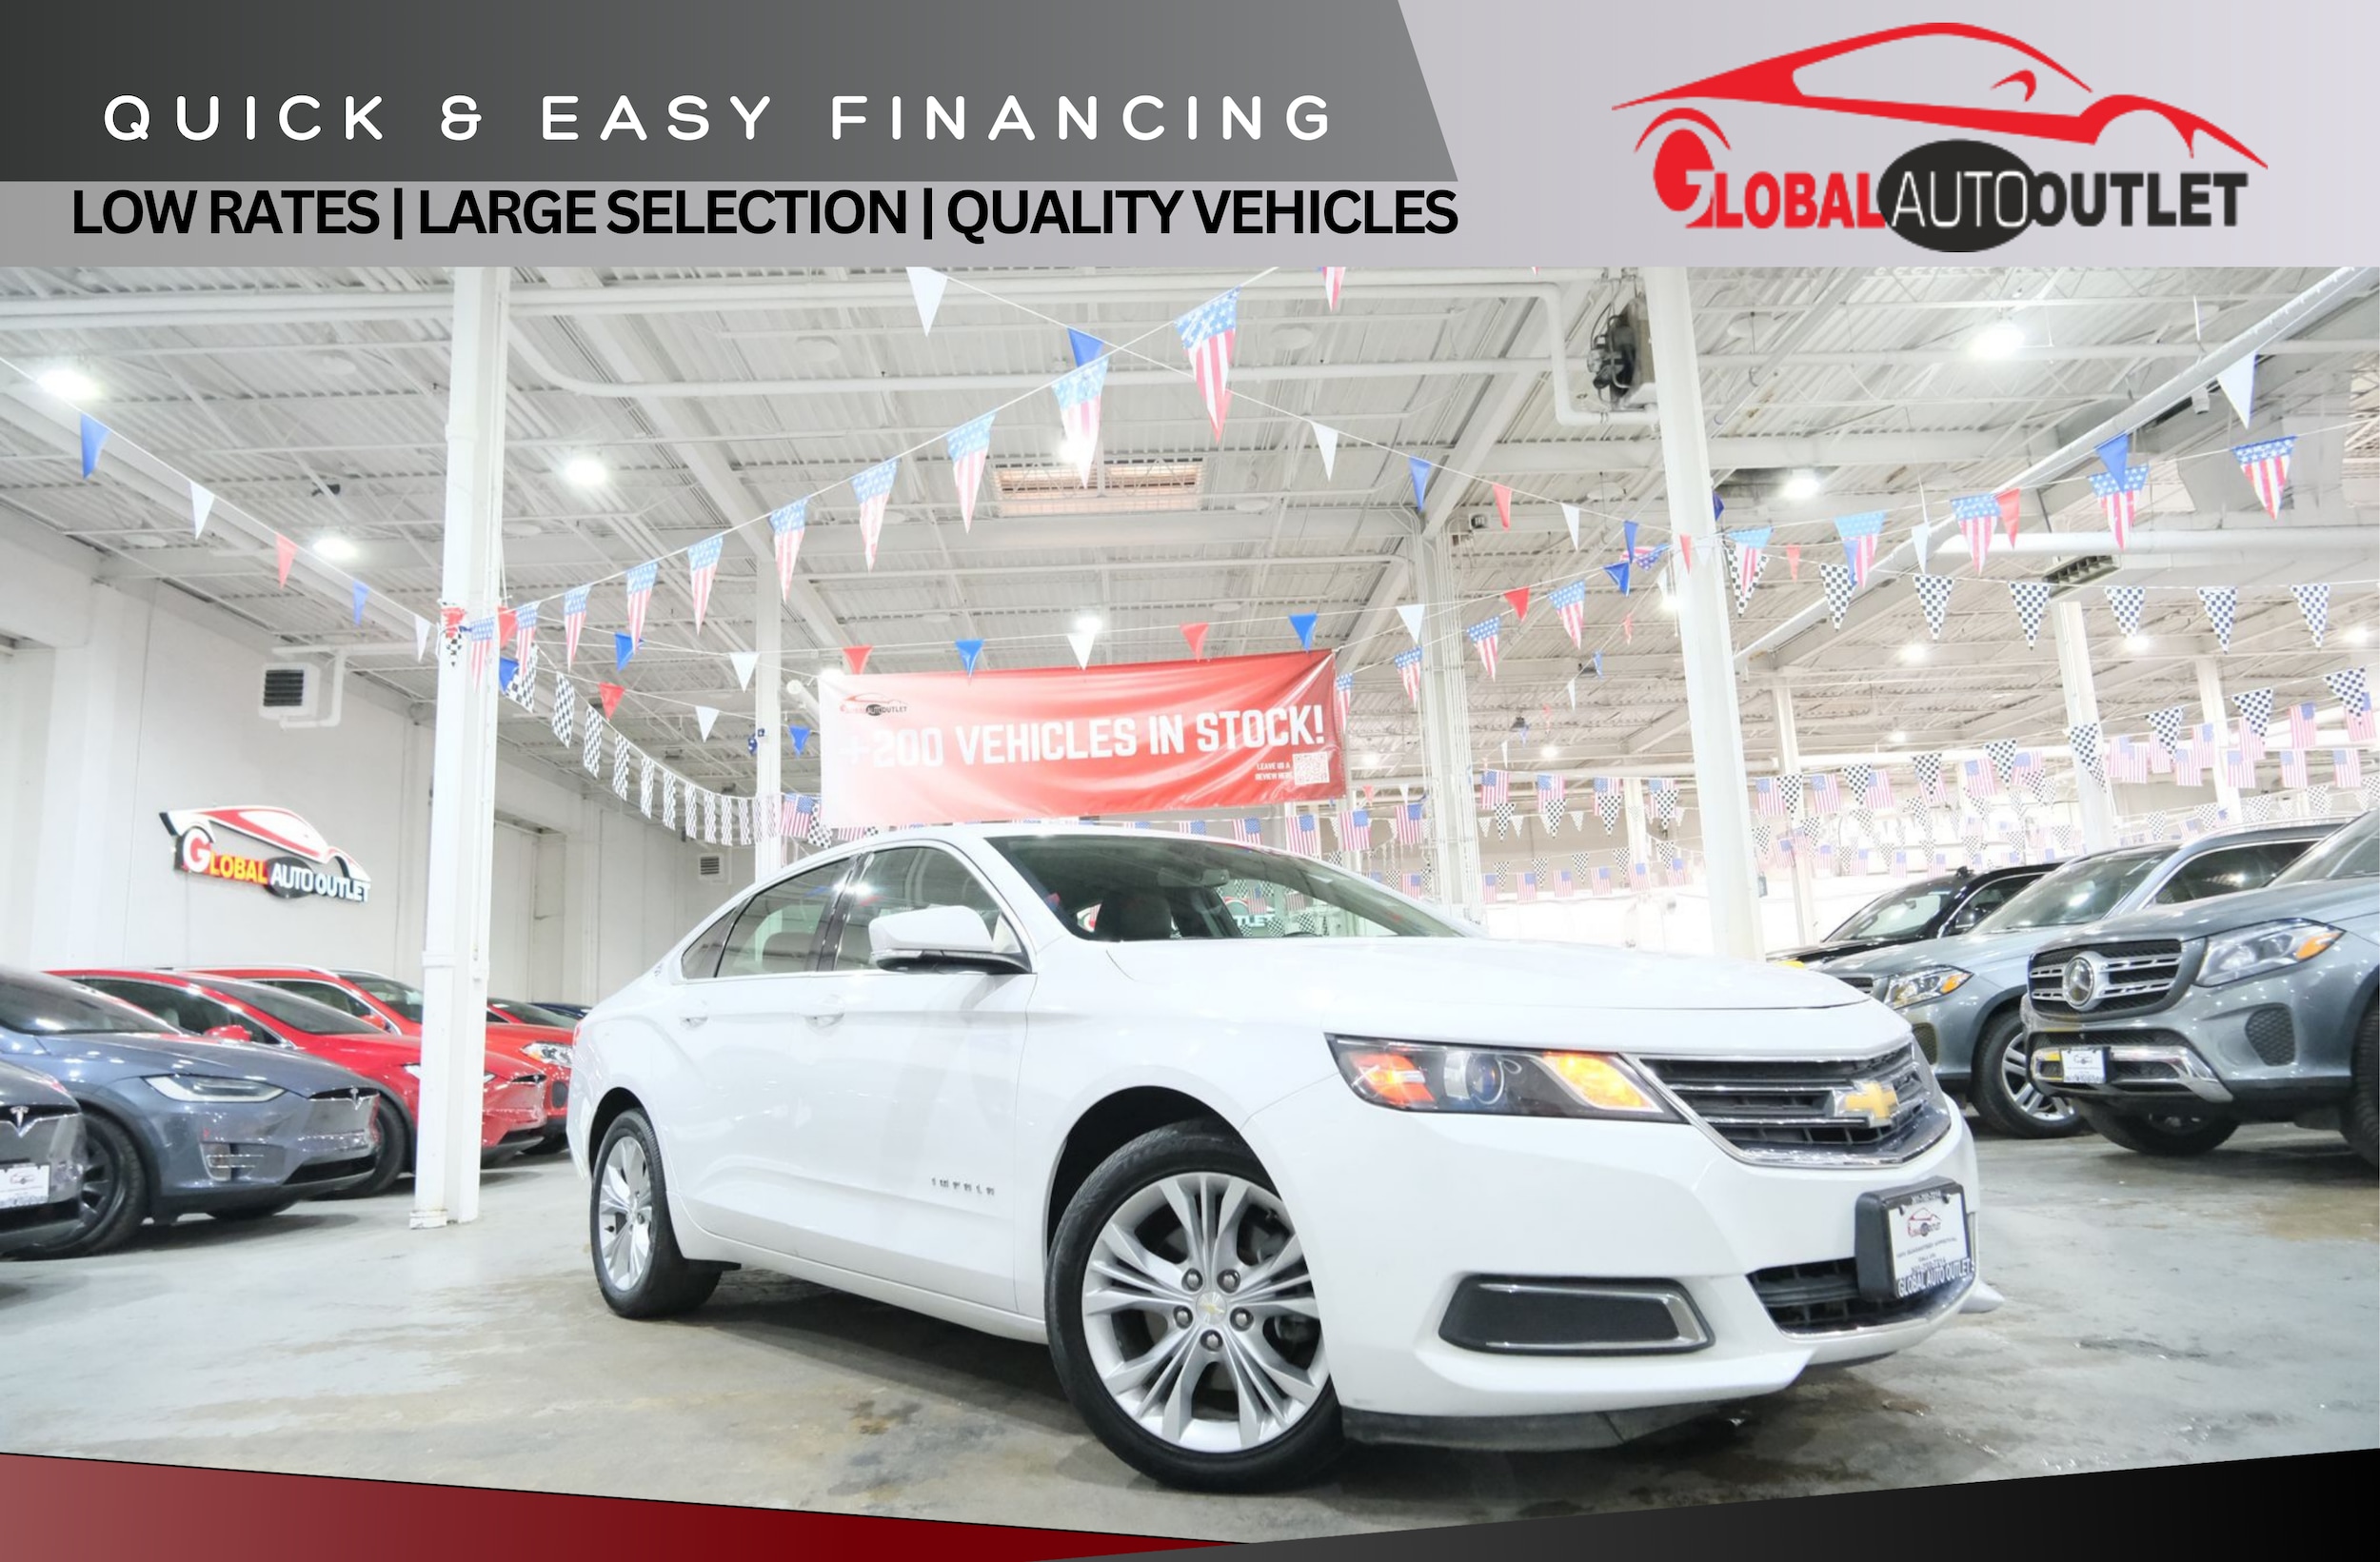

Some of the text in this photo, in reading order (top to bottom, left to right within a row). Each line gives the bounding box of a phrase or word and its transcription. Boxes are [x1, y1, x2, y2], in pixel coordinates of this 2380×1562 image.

[955, 717, 1138, 765] VEHICLES
[1149, 714, 1185, 755] IN
[1196, 704, 1326, 753] STOCK!
[183, 827, 371, 903] GLOBAL AUTO OUTLET
[1898, 1273, 1927, 1297] GLOBAL
[1927, 1267, 1945, 1288] AUTO
[1946, 1257, 1971, 1280] OUTLET
